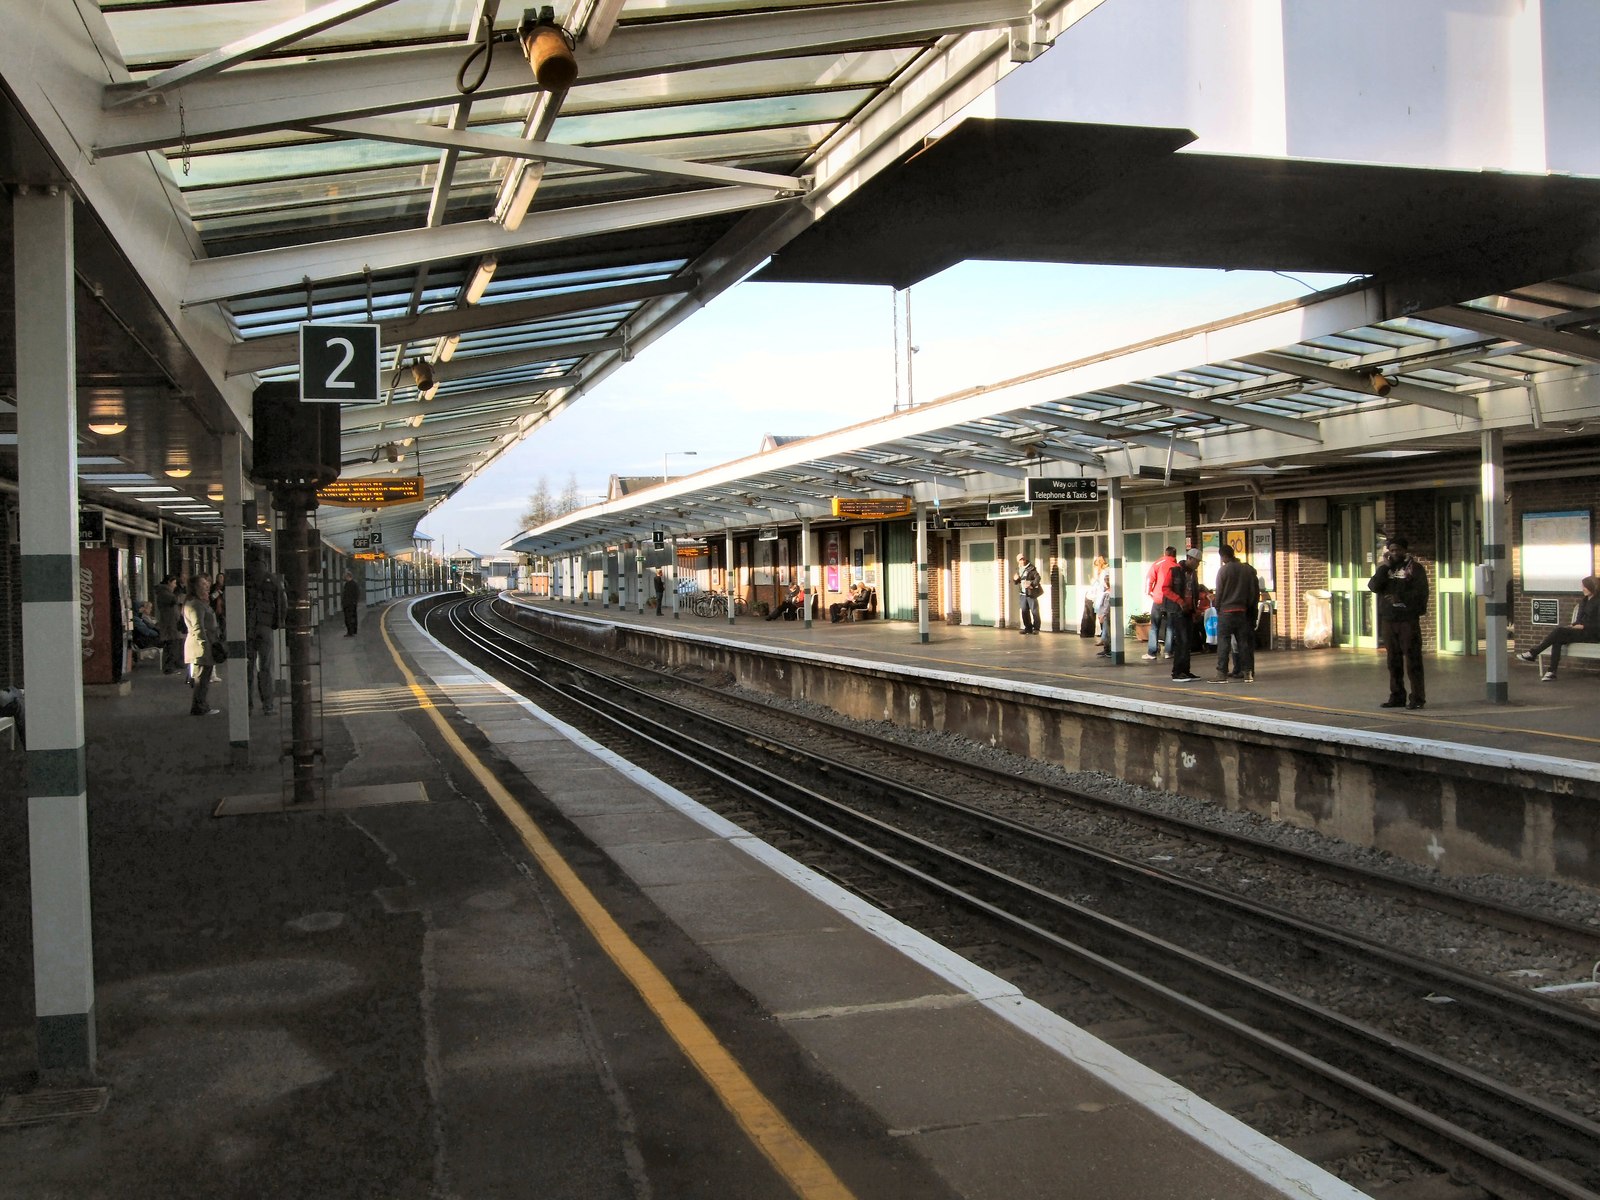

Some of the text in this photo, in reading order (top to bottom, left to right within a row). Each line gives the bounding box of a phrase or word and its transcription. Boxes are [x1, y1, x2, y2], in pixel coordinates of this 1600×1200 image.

[325, 337, 355, 389] 2
[1052, 480, 1066, 489] Way
[1034, 491, 1088, 500] Telephone & Taxis
[373, 533, 380, 543] 2
[1255, 535, 1264, 543] ZIP
[355, 539, 368, 547] OFF
